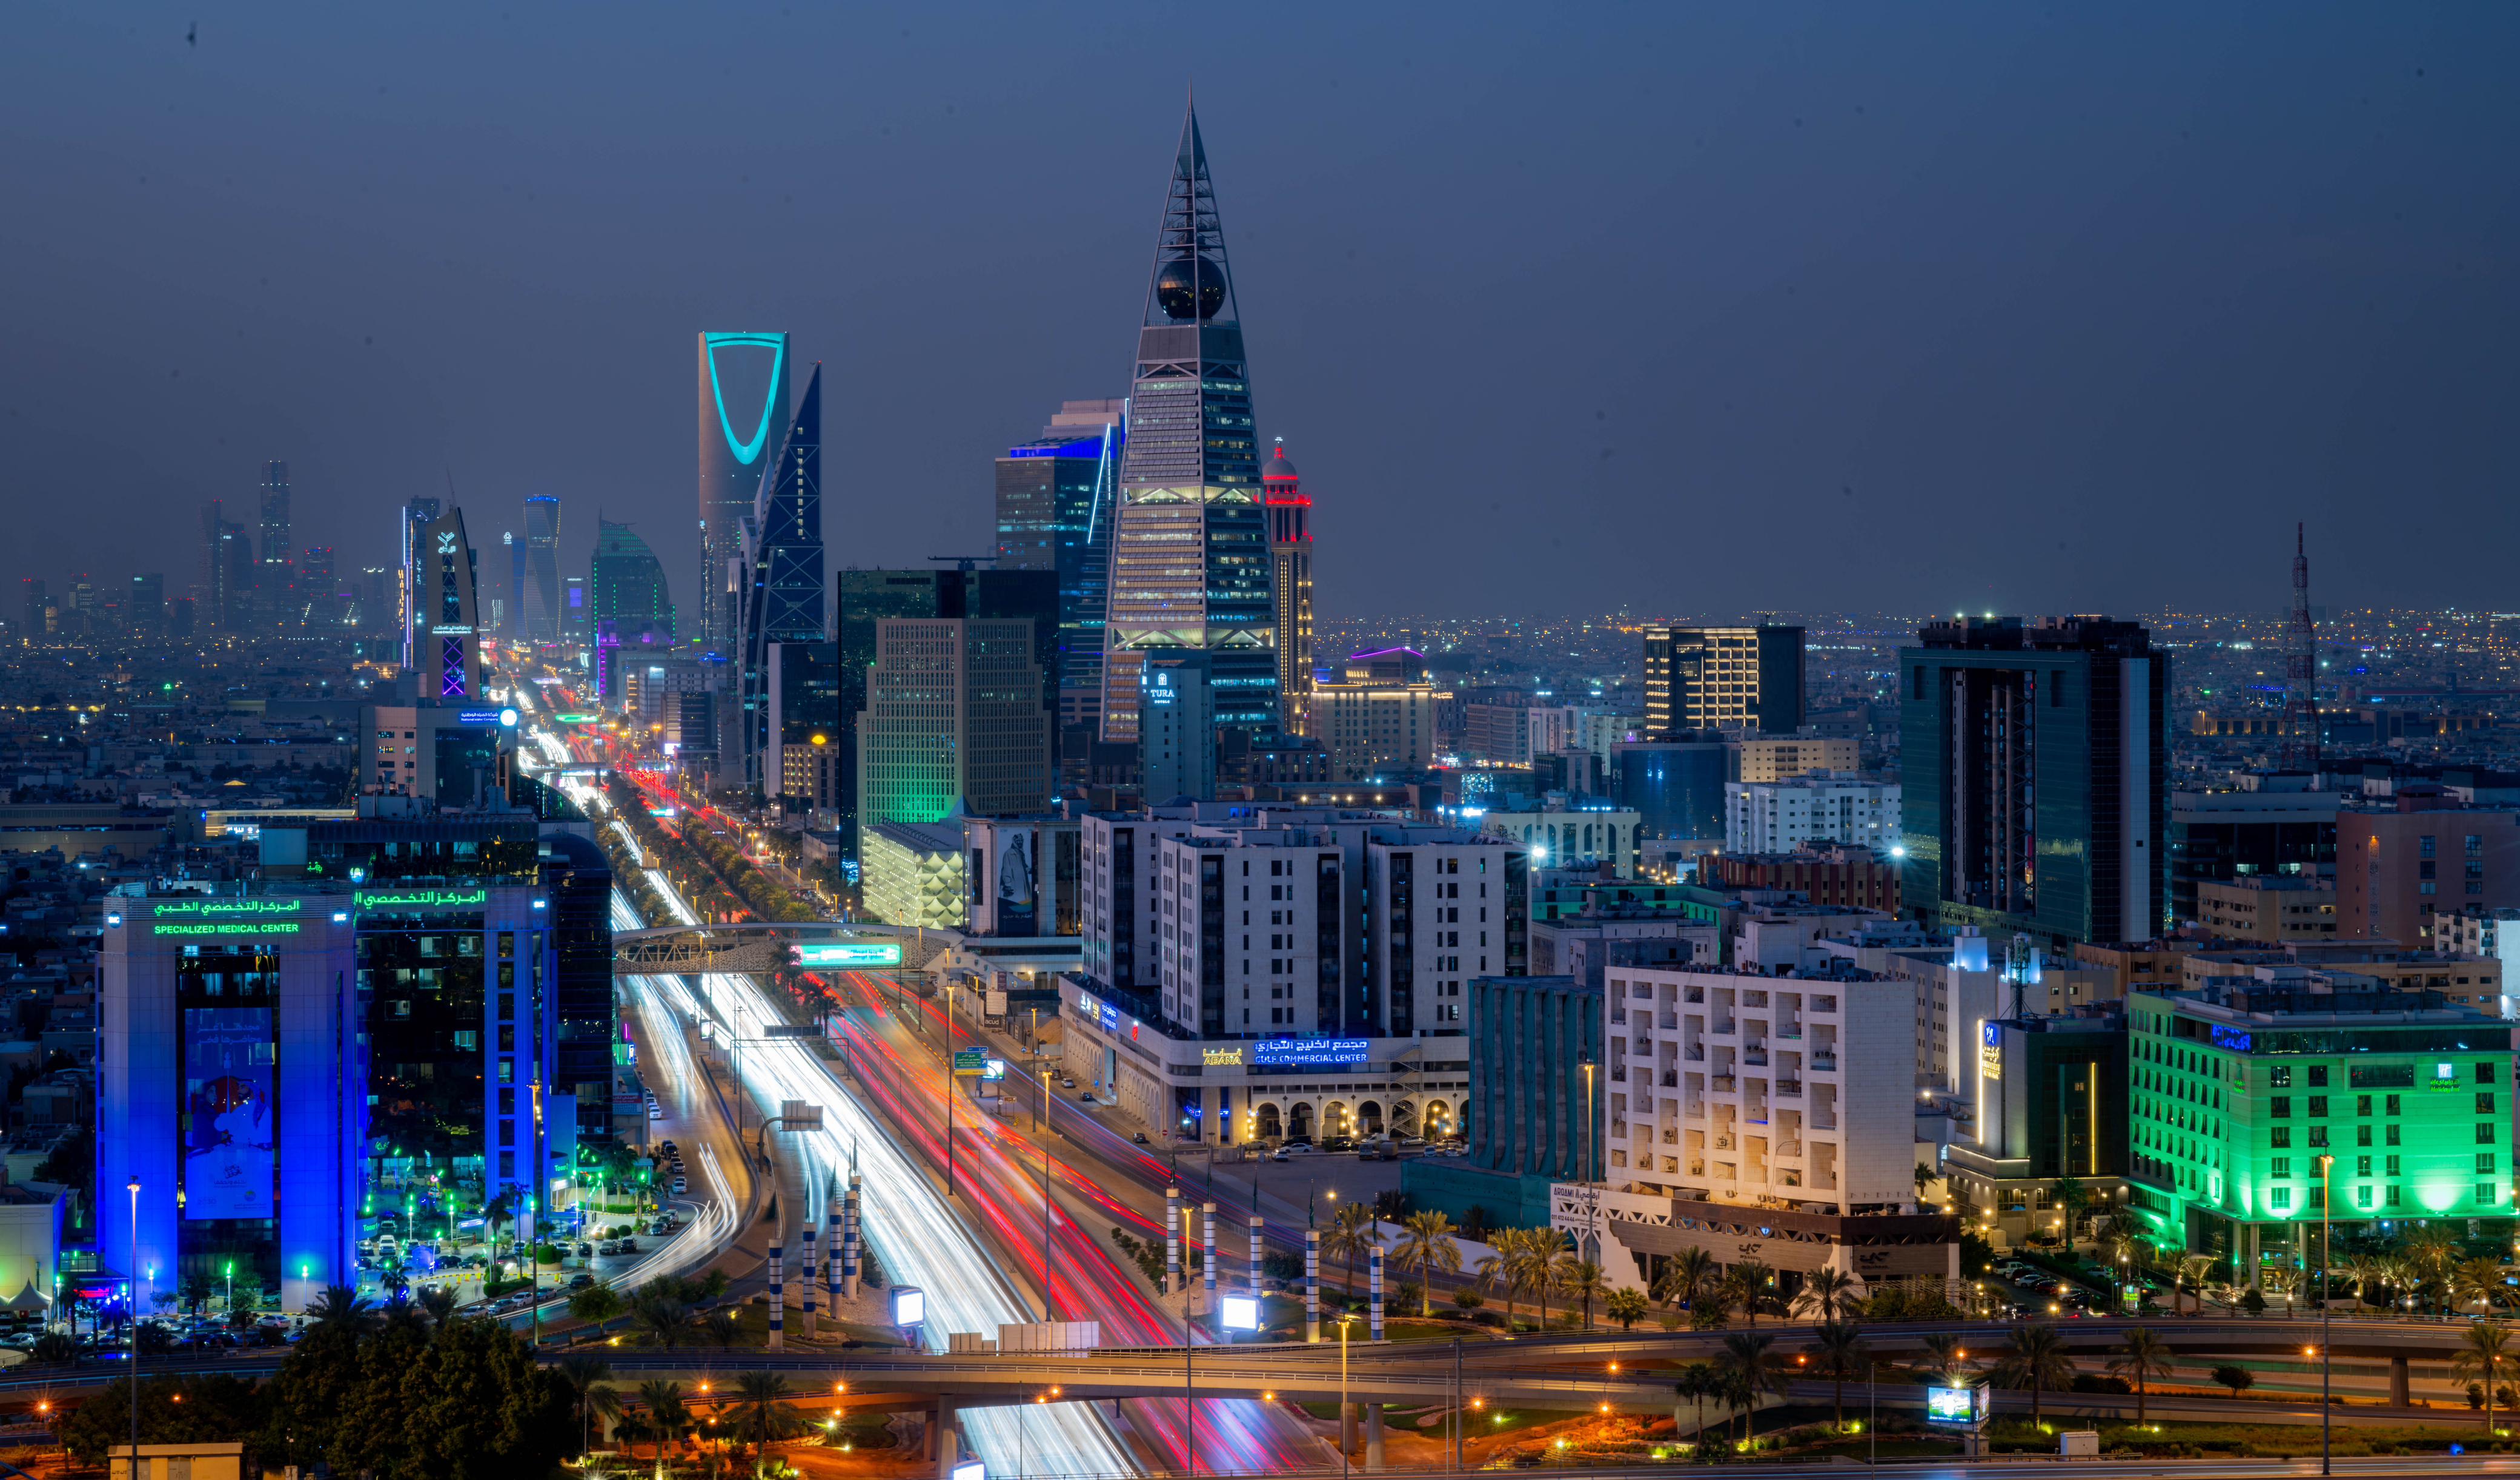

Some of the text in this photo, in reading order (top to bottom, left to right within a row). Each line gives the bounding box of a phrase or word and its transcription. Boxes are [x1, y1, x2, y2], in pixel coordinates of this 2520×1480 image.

[364, 891, 434, 908] التخصصي
[435, 890, 485, 906] المركز
[154, 900, 299, 916] المركز التخصصي الطبي
[154, 924, 299, 934] SPECIALIZED MEDICAL CENTER
[1255, 1040, 1367, 1052] مجمع الخليج التجاري
[1203, 1057, 1242, 1065] ABANA
[1279, 1054, 1333, 1063] COMMERCIAL
[1554, 1187, 1574, 1197] ARQAMI
[1580, 1191, 1600, 1200] أرقمي
